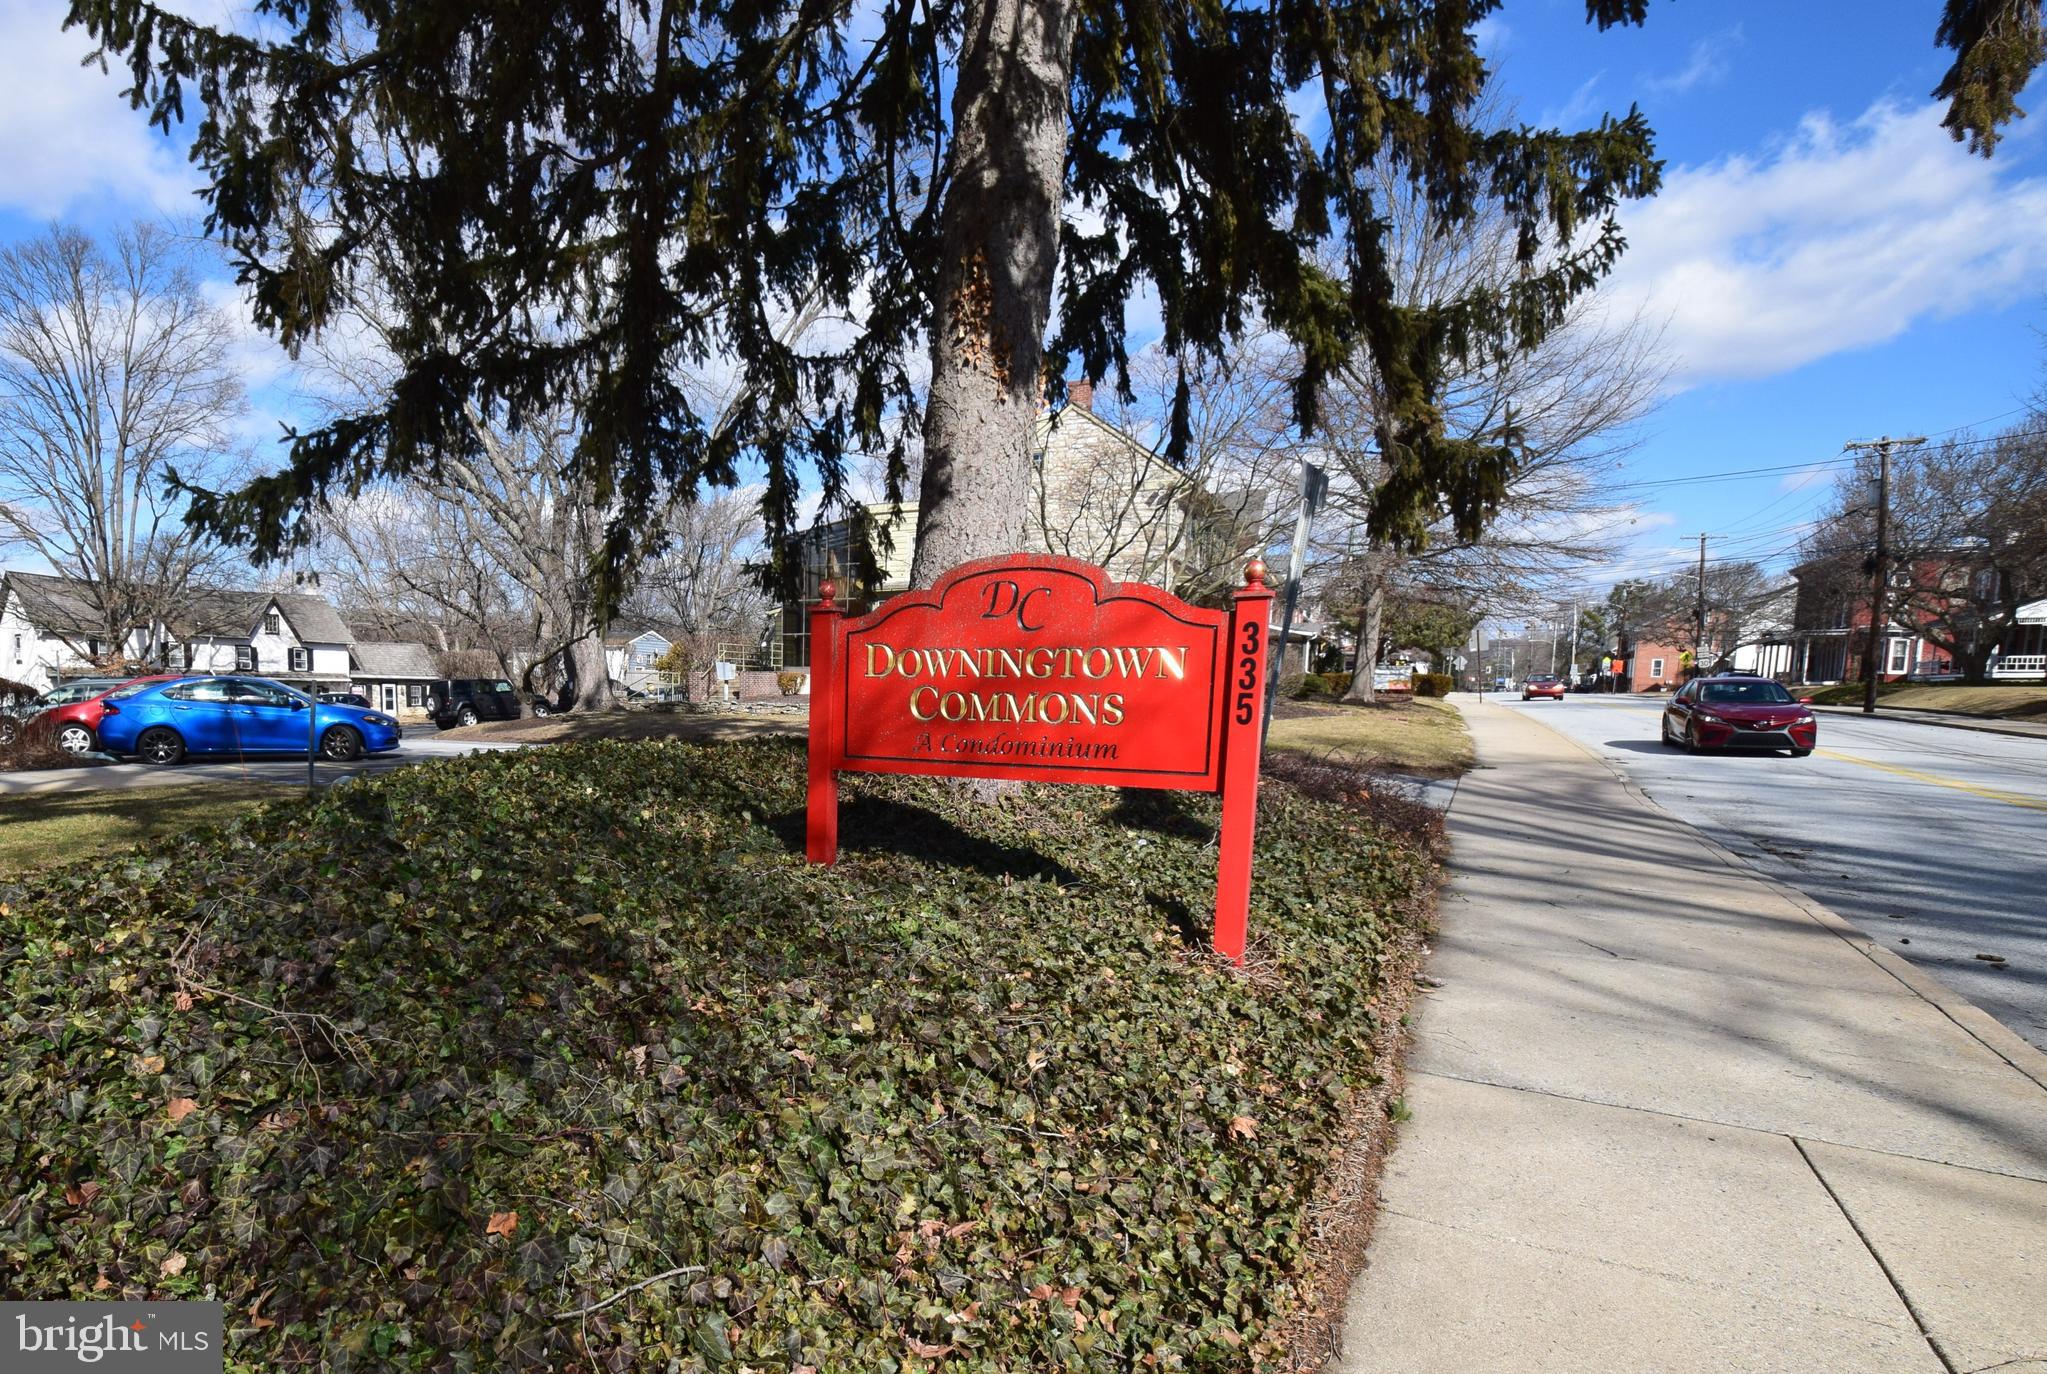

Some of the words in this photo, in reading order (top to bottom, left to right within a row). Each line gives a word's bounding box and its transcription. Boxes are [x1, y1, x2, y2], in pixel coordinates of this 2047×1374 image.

[864, 642, 1189, 681] DOWNINGTOWN
[1236, 621, 1260, 725] 335
[908, 684, 1126, 726] COMMONS
[912, 732, 932, 752] A
[940, 732, 1120, 760] Condominium
